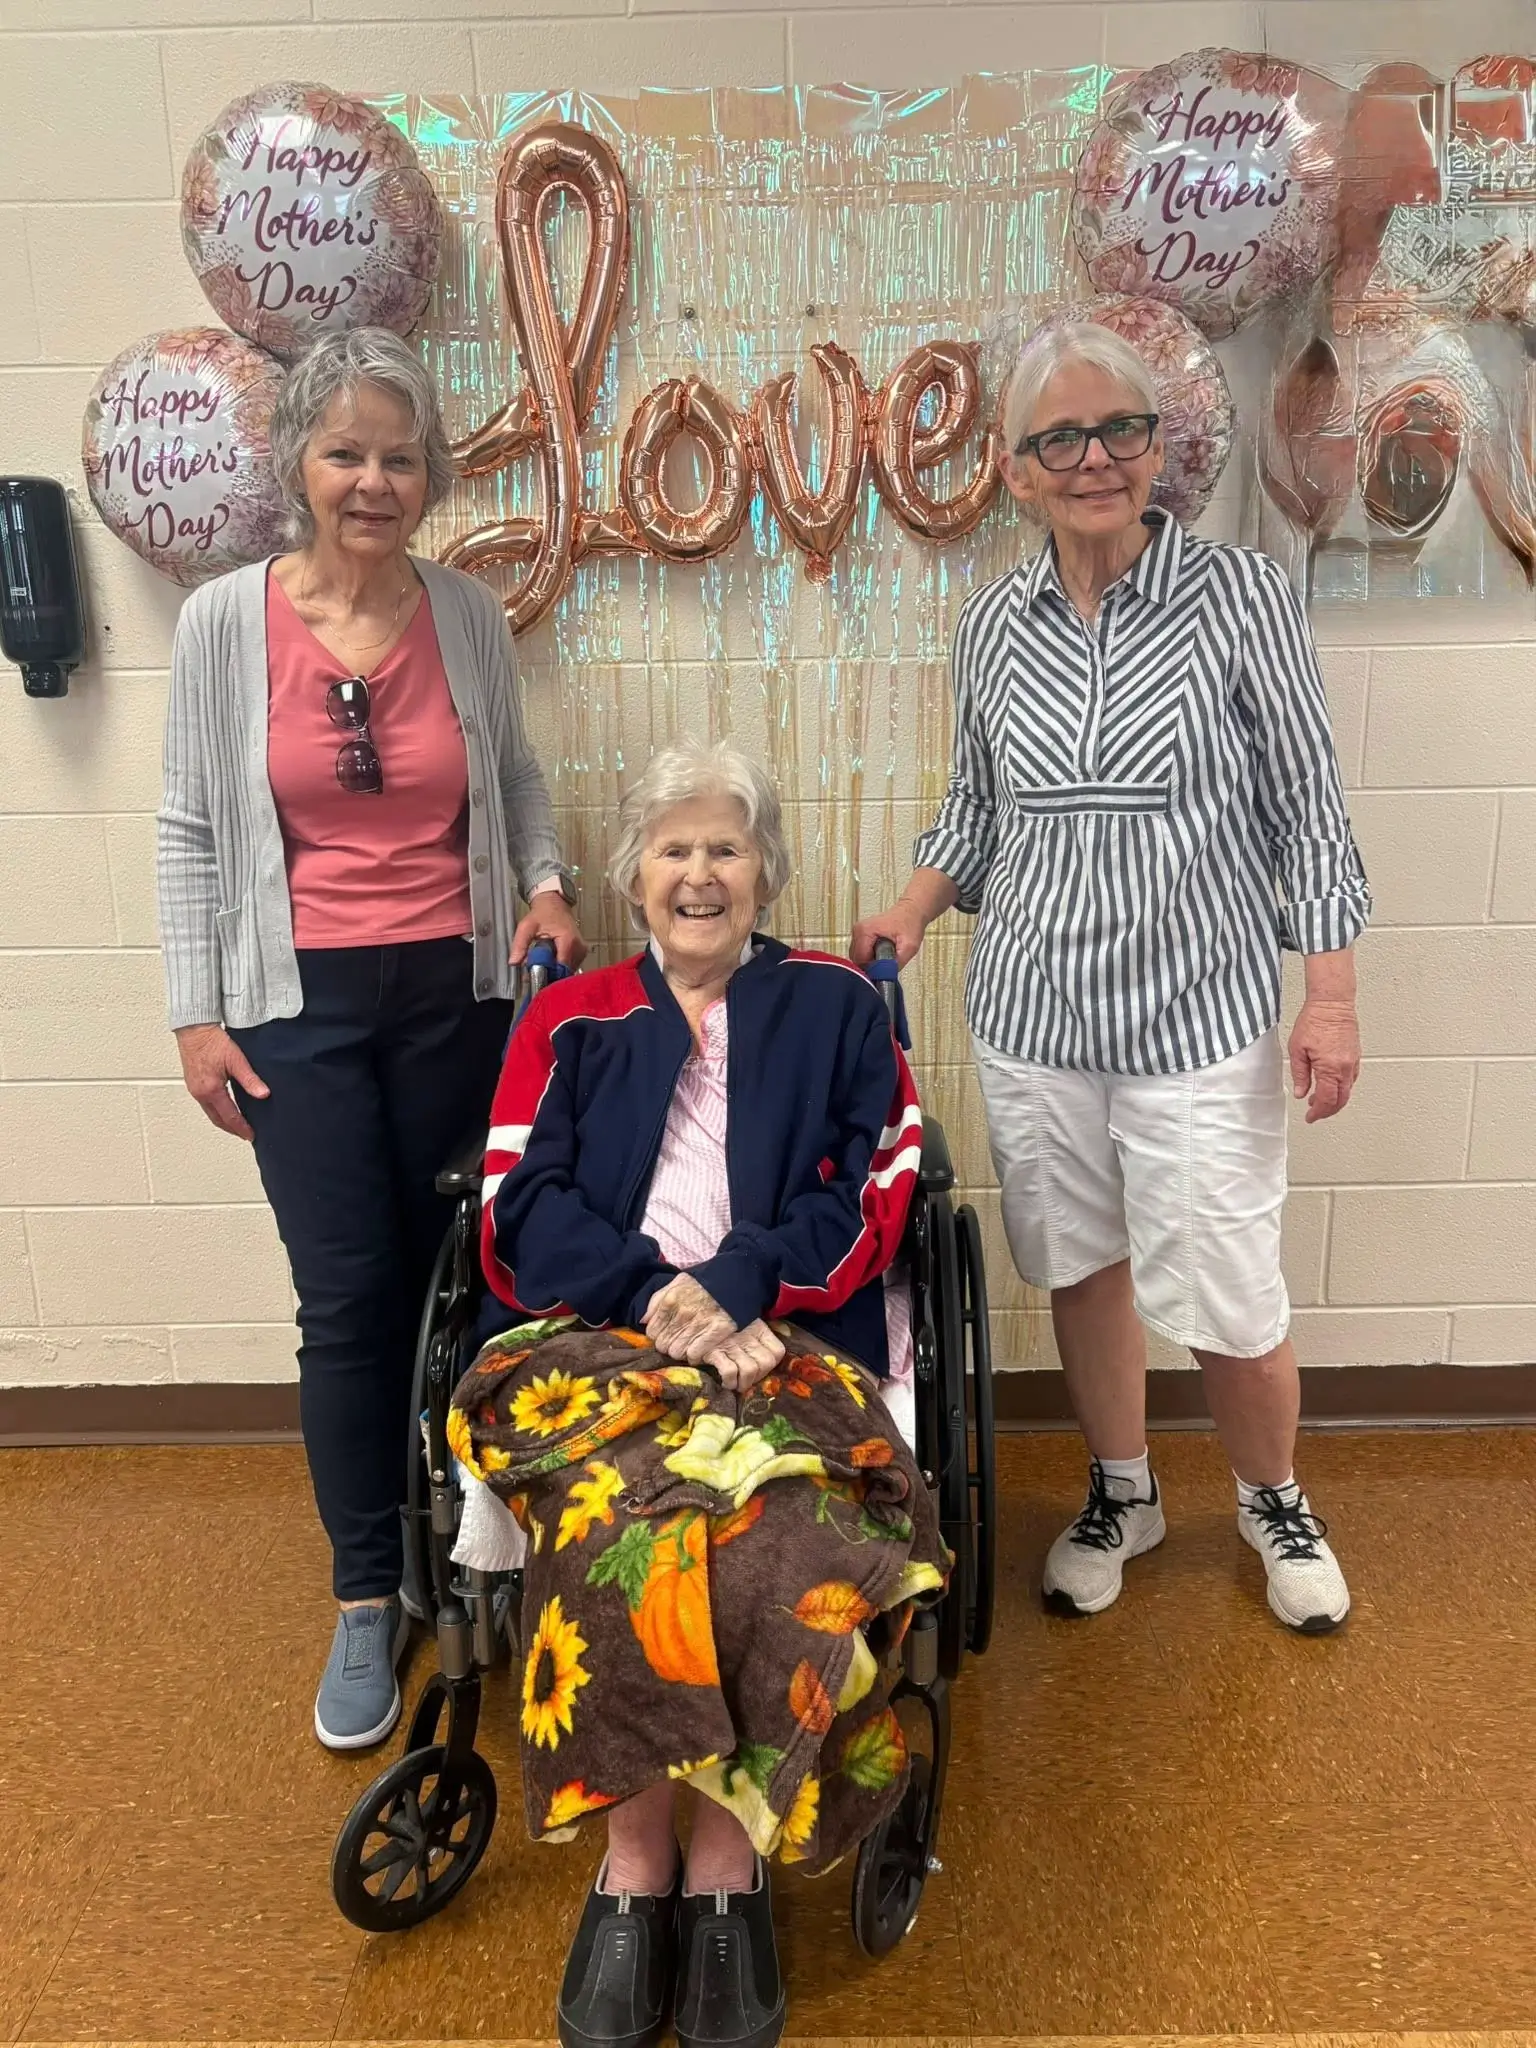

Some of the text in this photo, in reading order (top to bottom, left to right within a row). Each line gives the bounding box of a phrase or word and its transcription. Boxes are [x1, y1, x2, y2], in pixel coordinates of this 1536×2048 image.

[1142, 85, 1287, 152] Happy
[227, 118, 373, 188] Happy
[209, 186, 379, 253] Mother's
[1114, 154, 1292, 224] Mother's
[1135, 229, 1260, 290] Day
[235, 261, 358, 321] Day
[101, 370, 224, 429] Happy
[96, 435, 238, 497] Mother's
[122, 501, 230, 551] Day
